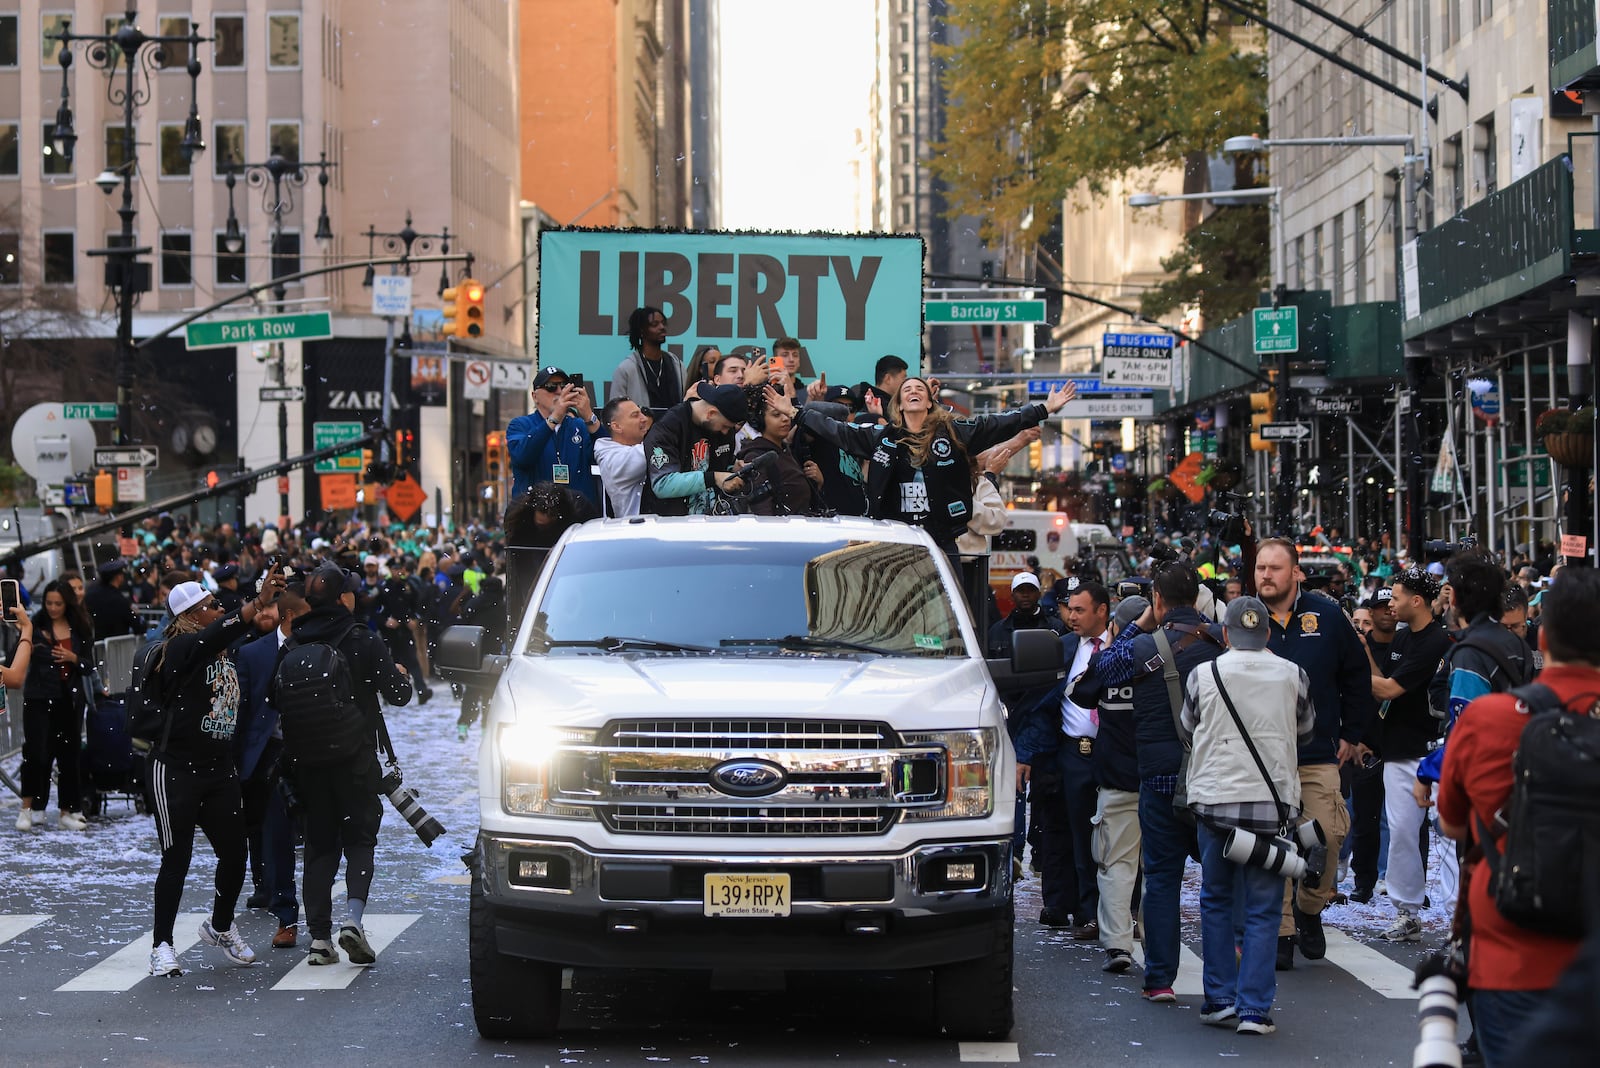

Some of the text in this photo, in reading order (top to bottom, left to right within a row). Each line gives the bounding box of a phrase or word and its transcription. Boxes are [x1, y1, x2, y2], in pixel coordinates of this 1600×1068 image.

[578, 250, 883, 341] LIBERTY
[951, 305, 1017, 320] Barclay St
[1259, 310, 1292, 321] CHURCH ST
[221, 320, 296, 340] Park Row
[1120, 335, 1170, 347] BUS LANE
[1261, 338, 1292, 349] BEST ROUTE
[1107, 348, 1168, 358] BUSES ONLY
[1121, 360, 1168, 371] 7AM-6PM
[1122, 372, 1166, 383] MON-FRI
[328, 390, 401, 409] ZARA
[65, 404, 96, 419] Park
[1088, 404, 1143, 413] BUSES ONLY
[1316, 399, 1352, 413] Barclay
[98, 452, 148, 463] ONE WAY
[730, 768, 767, 784] Ford
[726, 875, 768, 883] New Jersey
[710, 885, 784, 906] L39 RPX
